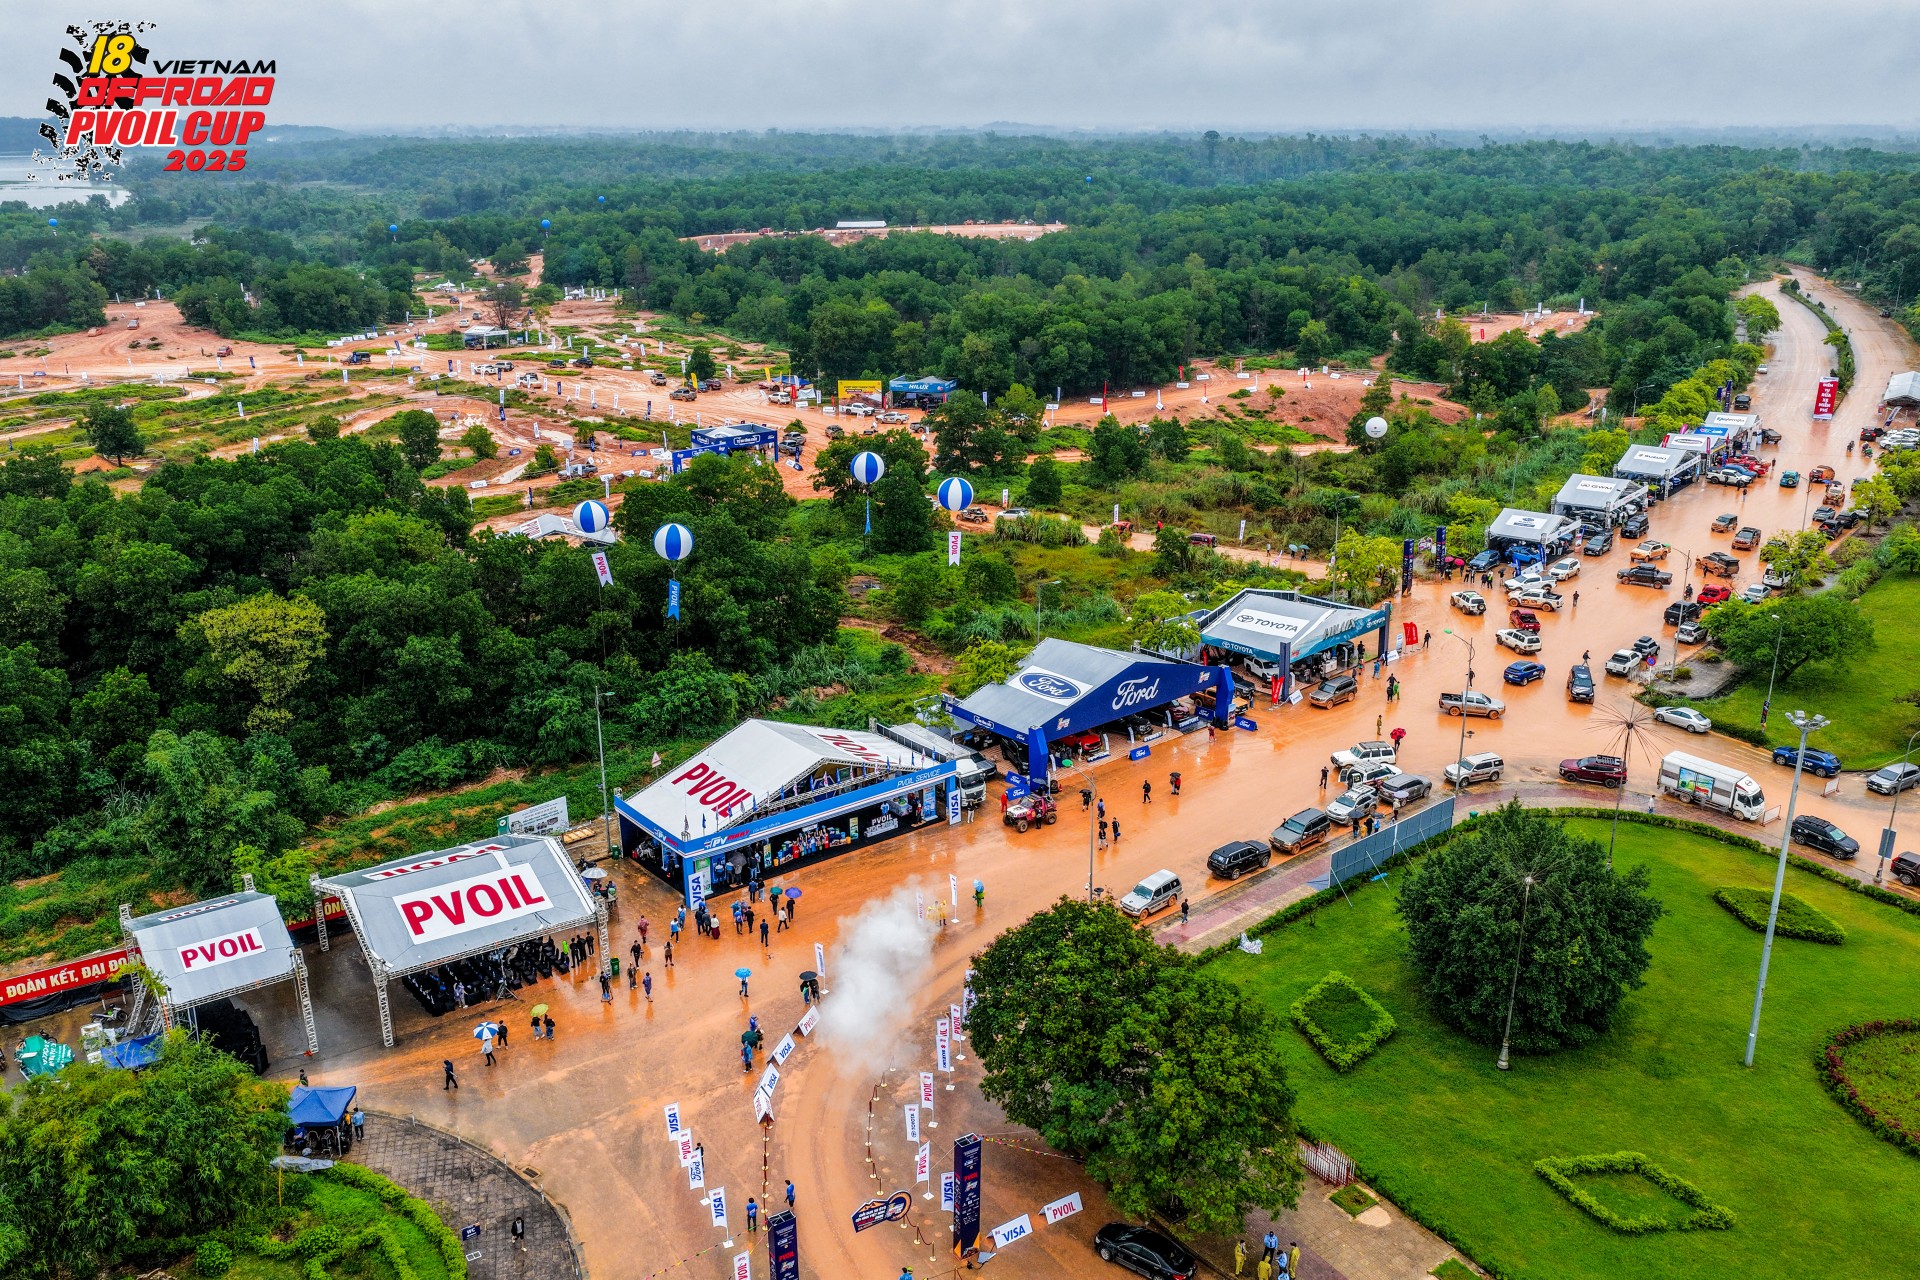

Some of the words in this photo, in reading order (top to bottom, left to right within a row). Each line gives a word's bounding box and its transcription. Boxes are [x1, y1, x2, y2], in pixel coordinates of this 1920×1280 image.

[951, 535, 959, 556] PVOIL
[595, 556, 608, 577] PVOIL
[670, 584, 679, 607] PVOIL
[1254, 618, 1298, 633] TOYOTA
[1230, 643, 1253, 654] TOYOTA
[1028, 676, 1070, 697] Ford
[1112, 676, 1160, 710] Ford
[1239, 720, 1250, 728] Ford
[1135, 749, 1146, 758] Ford
[896, 778, 914, 789] PVOIL
[915, 768, 941, 783] SERVICE
[1010, 775, 1021, 784] Ford
[671, 762, 753, 818] PVOIL
[1012, 788, 1025, 797] Ford
[951, 793, 959, 820] VISA
[871, 813, 893, 826] PVOIL
[692, 875, 702, 906] VISA
[400, 874, 546, 936] PVOIL
[180, 933, 263, 969] PVOIL
[6, 976, 47, 998] ĐOÀN
[50, 967, 79, 988] KẾT,
[82, 958, 105, 979] ĐẠI
[803, 1014, 817, 1032] PVOIL
[779, 1042, 792, 1059] VISA
[767, 1072, 778, 1090] VISA
[923, 1083, 933, 1102] PVOIL
[668, 1112, 679, 1134] VISA
[690, 1160, 702, 1182] Ford
[918, 1153, 927, 1176] PVOIL
[944, 1180, 953, 1204] VISA
[715, 1196, 725, 1220] VISA
[1052, 1201, 1076, 1219] PVOIL
[1002, 1224, 1026, 1242] VISA
[737, 1262, 749, 1280] VOIL
